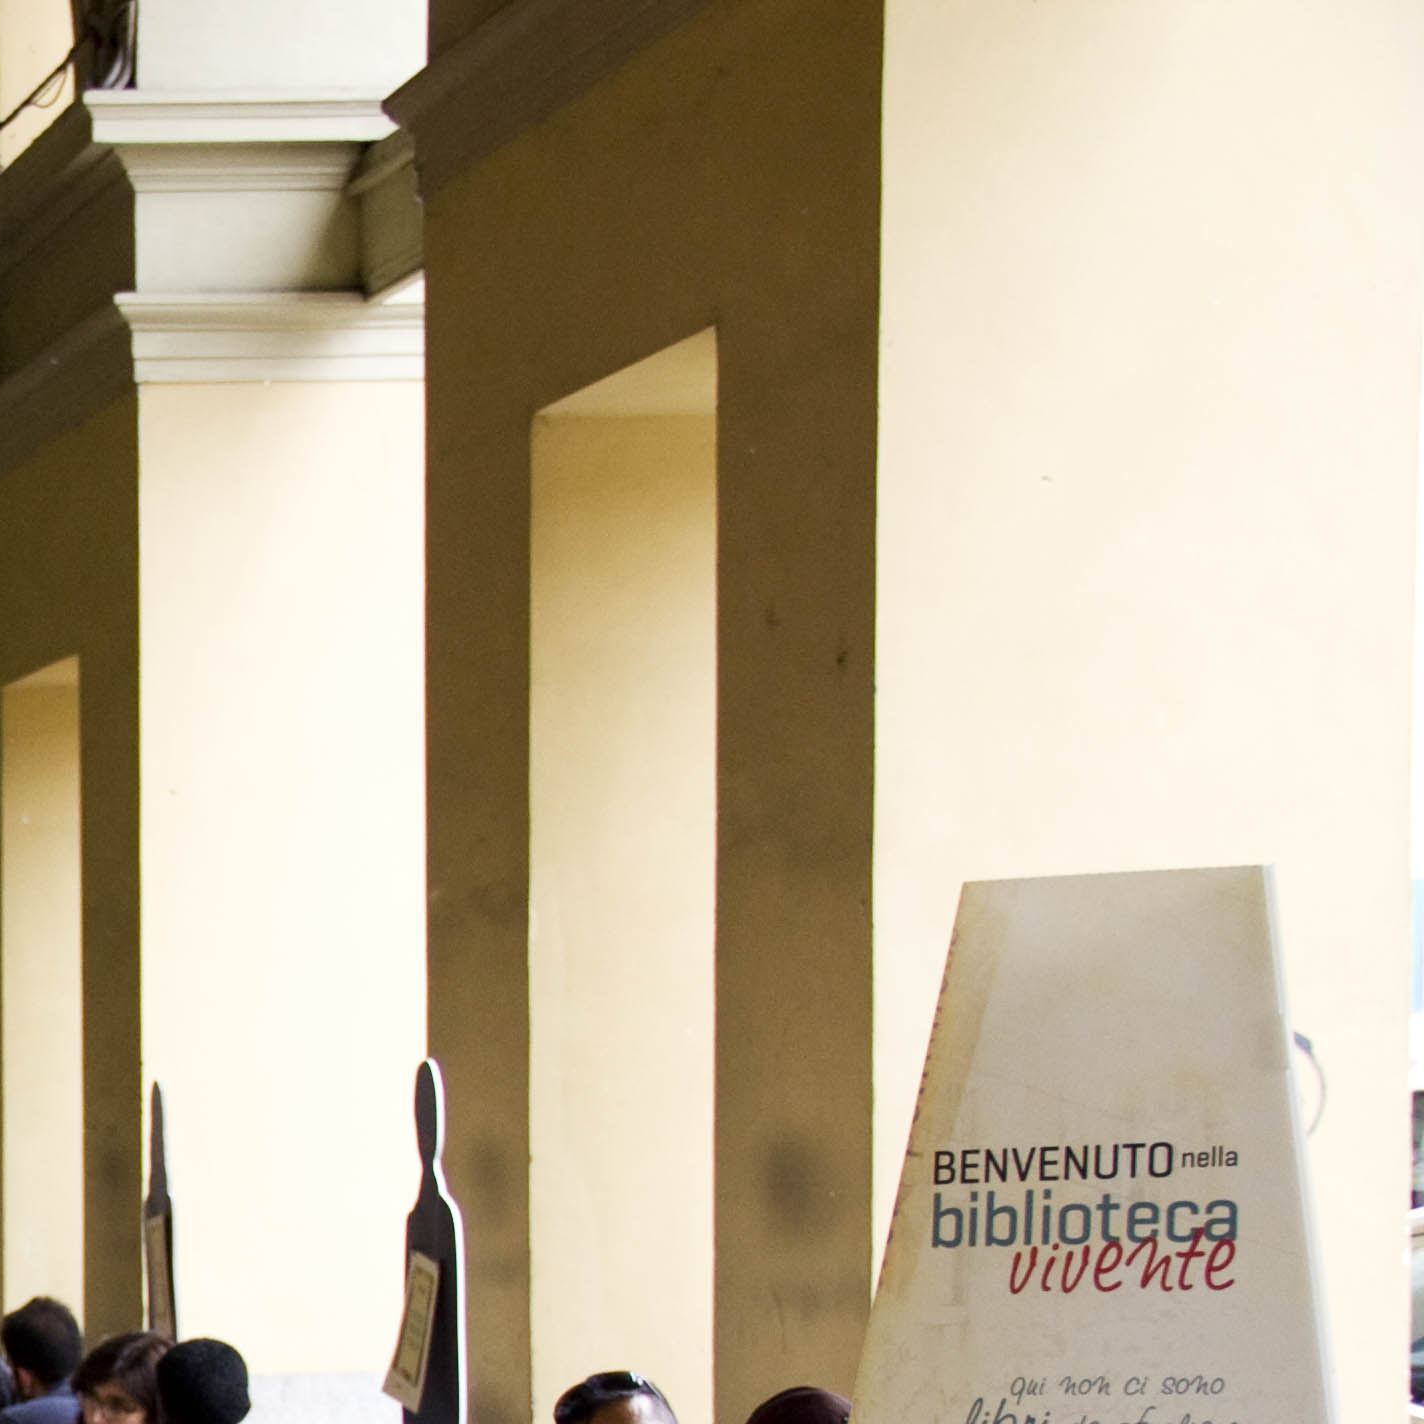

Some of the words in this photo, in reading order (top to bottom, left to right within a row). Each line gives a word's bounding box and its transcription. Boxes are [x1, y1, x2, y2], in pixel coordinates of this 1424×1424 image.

[933, 1141, 1174, 1185] BENVENUTO
[1180, 1145, 1239, 1169] nella
[931, 1189, 1238, 1248] biblioteca
[1009, 1227, 1236, 1294] vivente
[1010, 1376, 1047, 1405] qui
[1058, 1376, 1111, 1396] non
[1123, 1376, 1147, 1395] ci
[1160, 1376, 1225, 1396] sono
